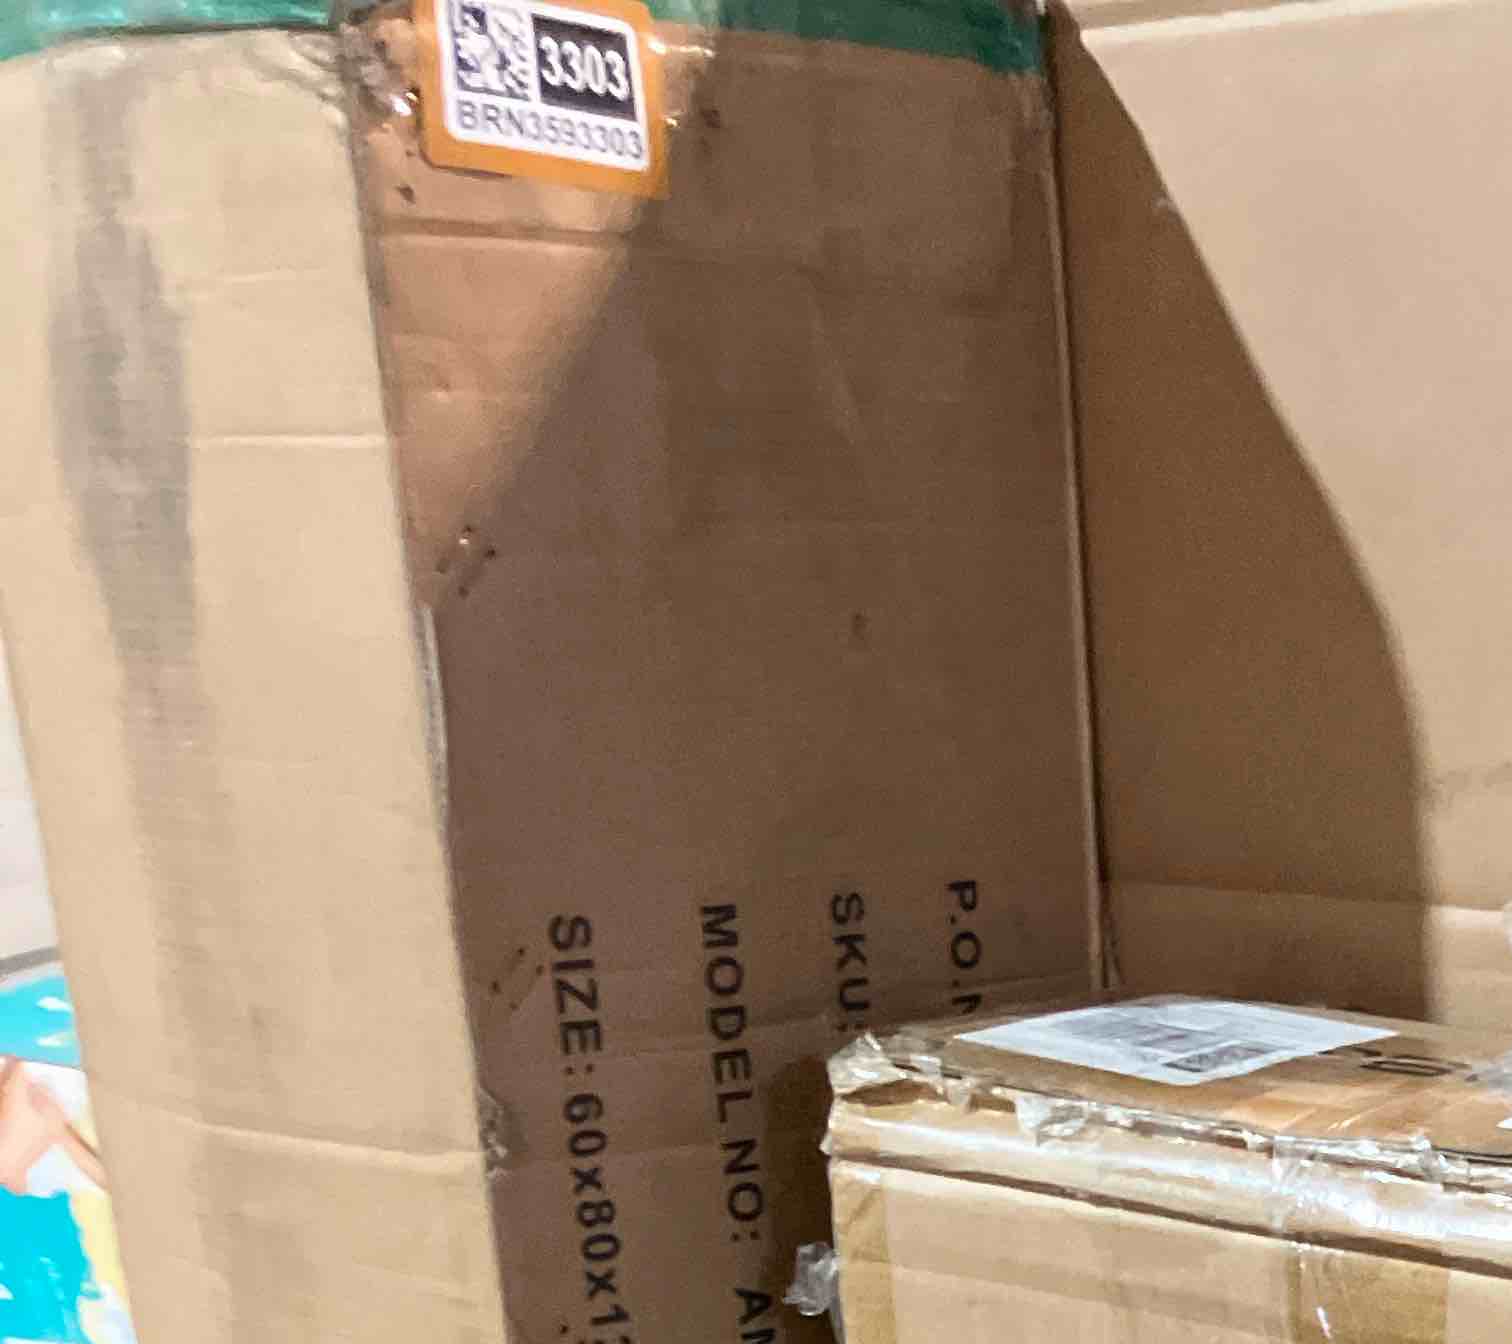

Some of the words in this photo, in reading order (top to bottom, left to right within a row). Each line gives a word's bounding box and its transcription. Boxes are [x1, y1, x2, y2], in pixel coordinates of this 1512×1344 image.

[540, 36, 630, 101] 3303
[457, 99, 643, 159] BRN3593303
[700, 904, 754, 1123] MODEL
[721, 1138, 765, 1243] NO:
